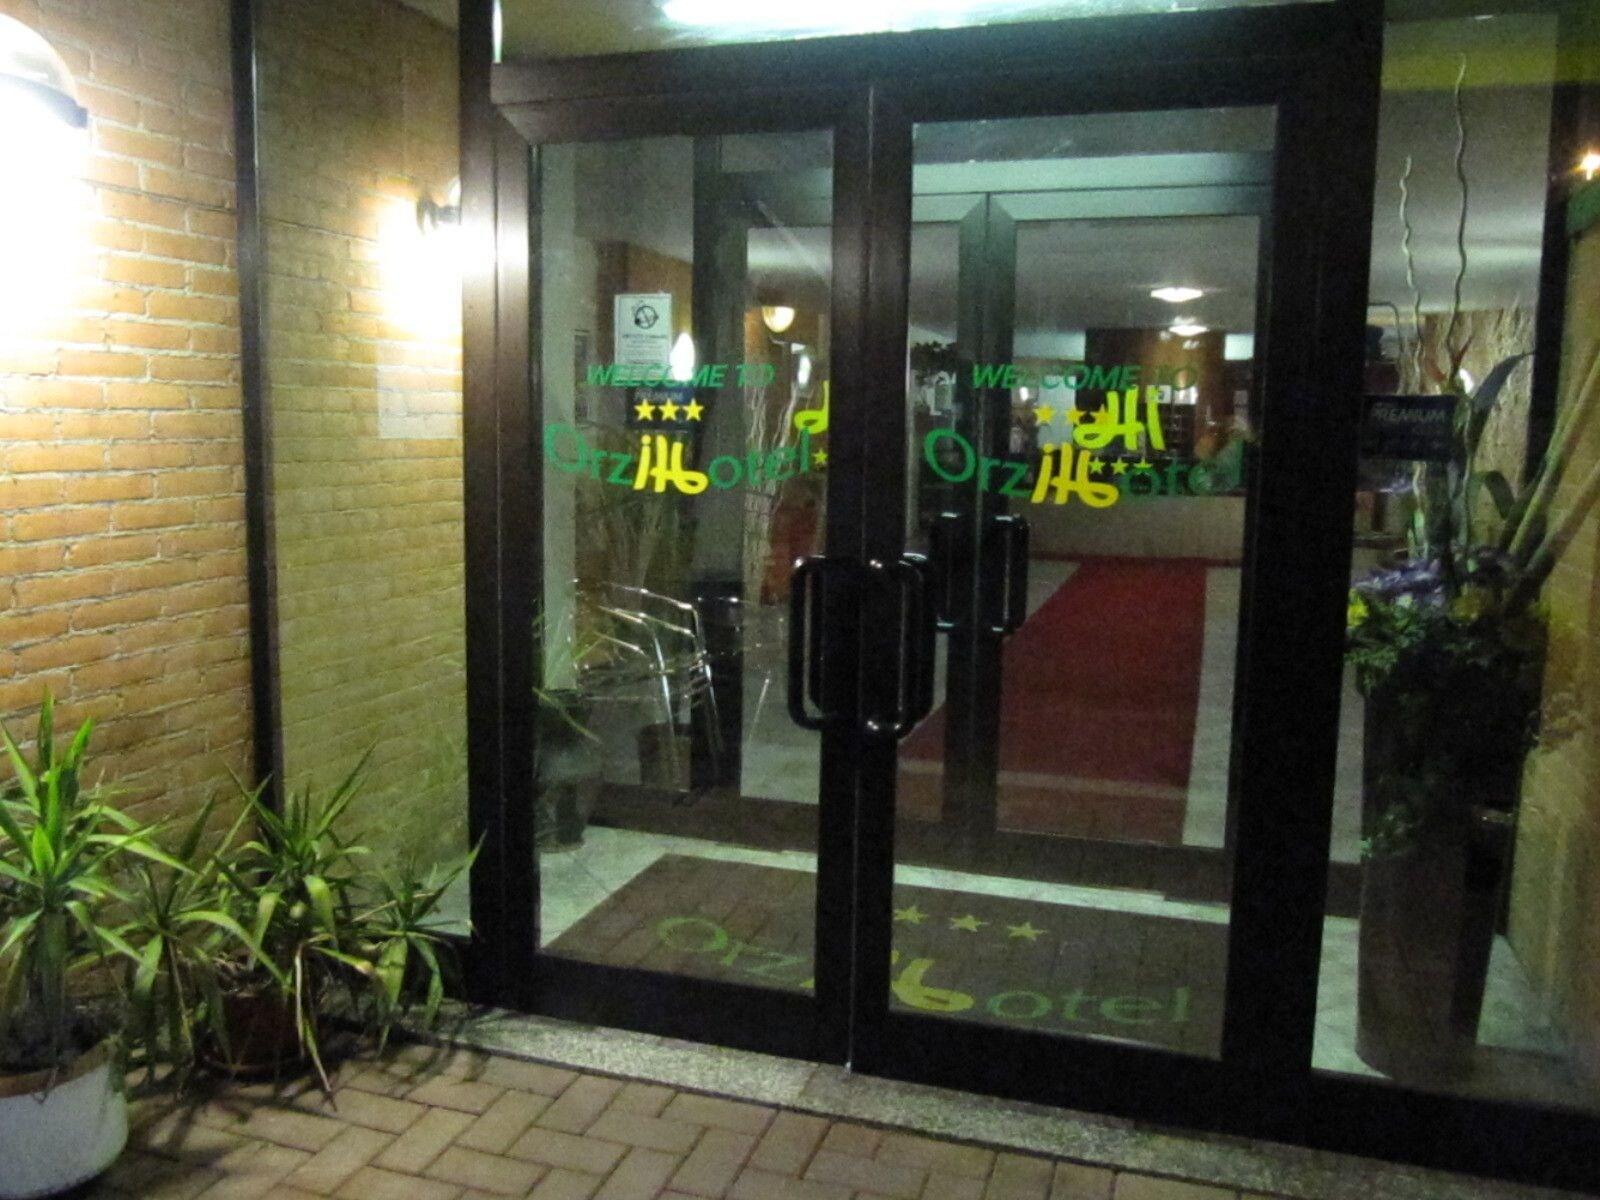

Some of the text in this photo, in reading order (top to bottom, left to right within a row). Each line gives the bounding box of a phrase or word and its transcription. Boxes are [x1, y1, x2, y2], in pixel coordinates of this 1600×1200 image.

[586, 363, 776, 388] WELCOME TO
[971, 364, 1142, 390] WELCOME
